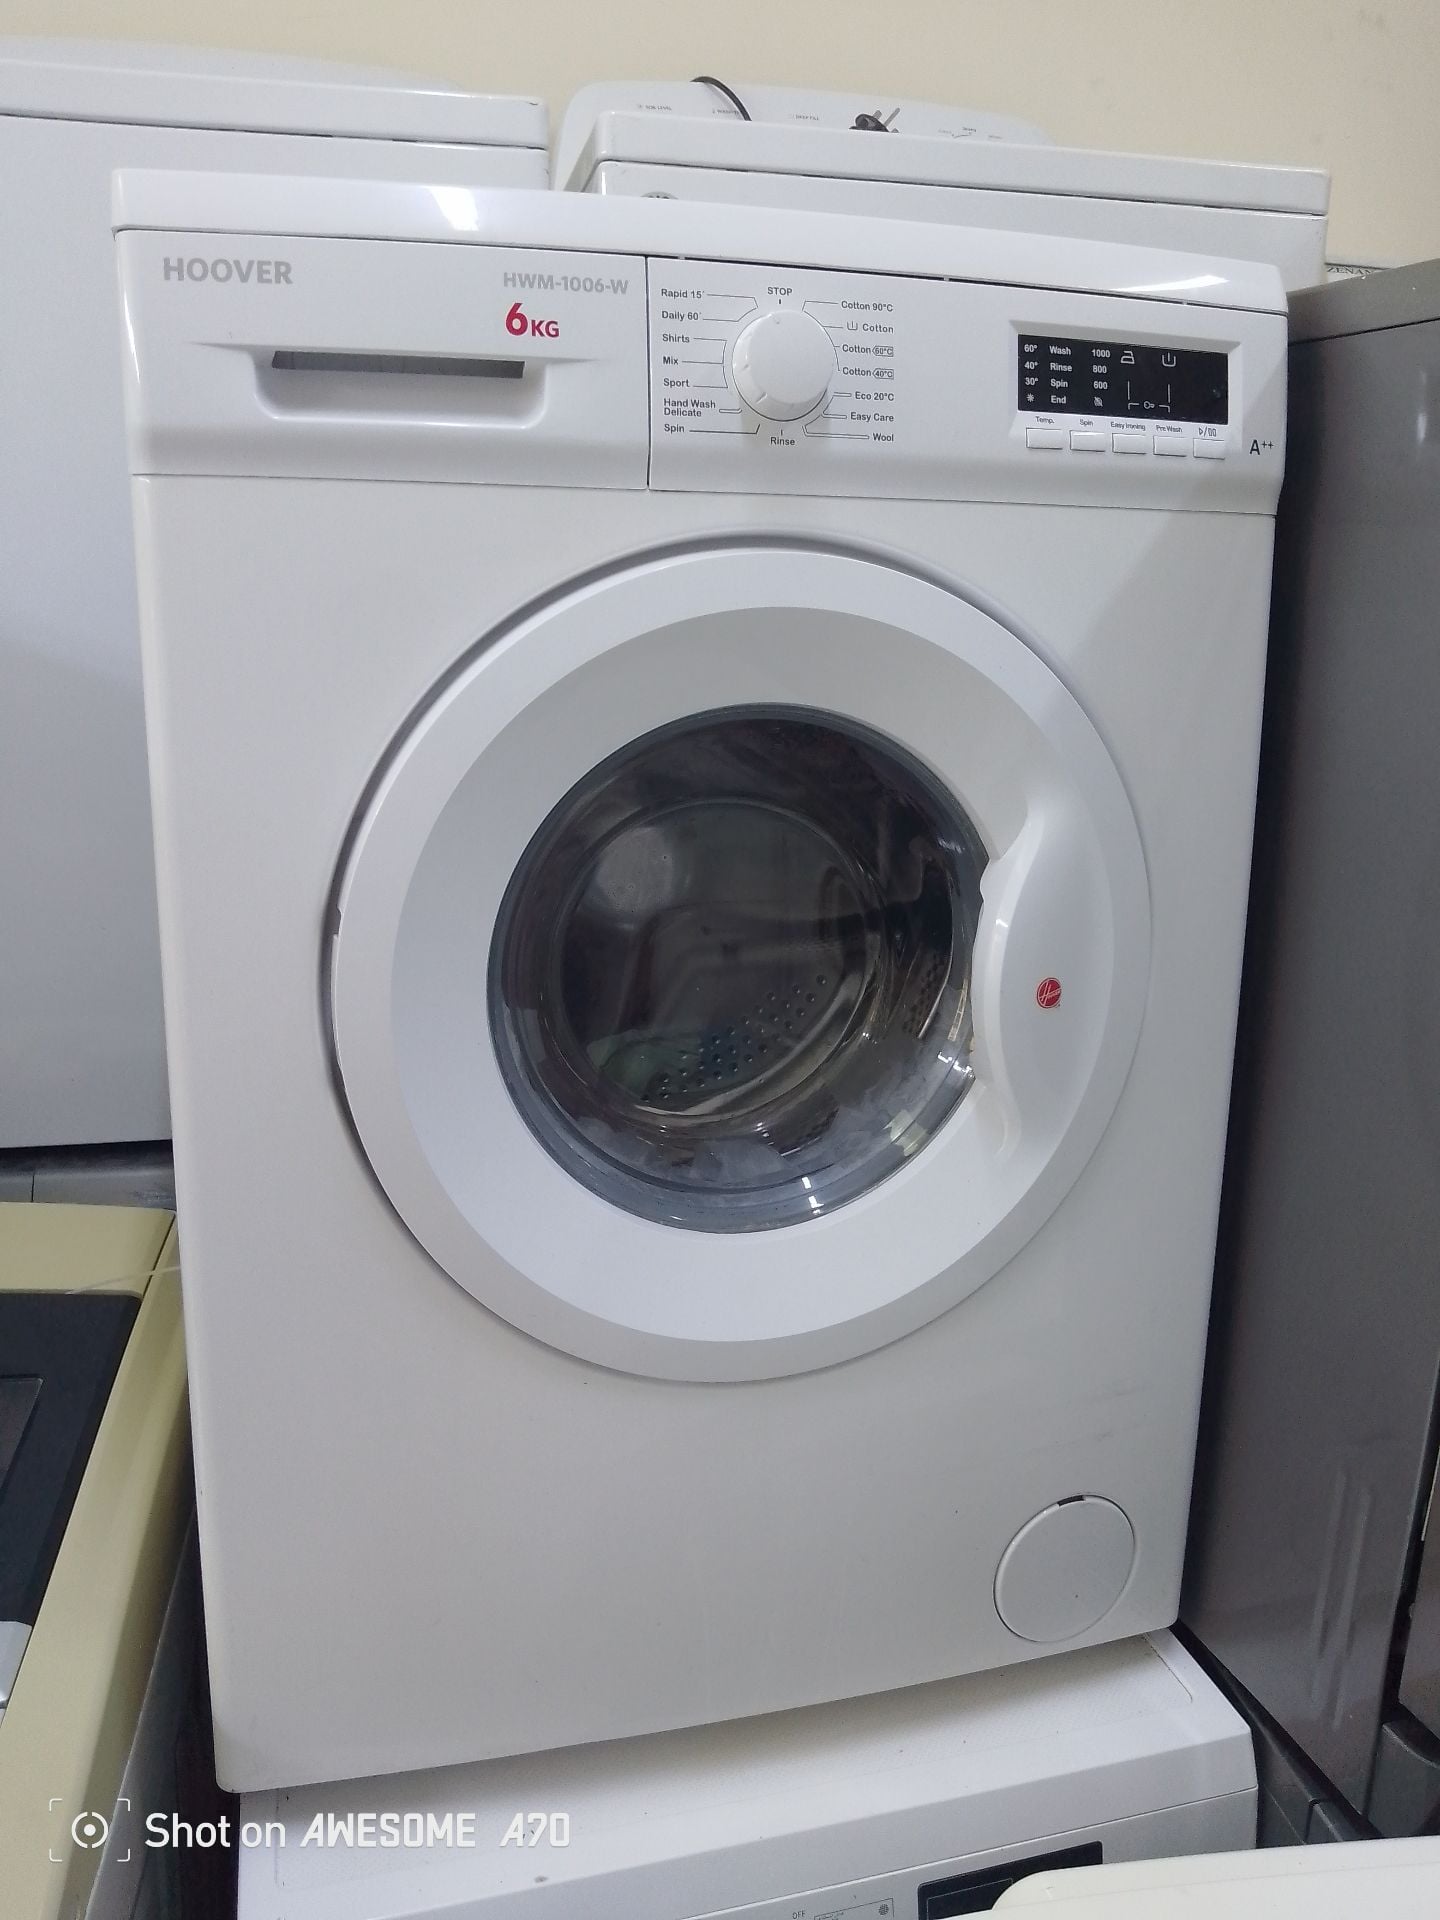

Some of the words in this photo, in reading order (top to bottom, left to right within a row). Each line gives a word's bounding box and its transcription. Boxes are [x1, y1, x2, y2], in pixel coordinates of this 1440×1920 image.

[163, 257, 293, 285] HOOVER
[503, 271, 629, 295] HWM-1006-W
[661, 289, 688, 299] Rapid
[768, 287, 792, 296] STOP
[841, 301, 870, 310] Cotton
[872, 303, 893, 312] 90°C
[662, 311, 685, 321] Daily
[862, 323, 893, 333] Cotton
[662, 334, 690, 343] Shirts
[842, 344, 871, 354] Cotton
[1049, 346, 1071, 355] Wash
[1092, 349, 1110, 358] 1000
[663, 356, 679, 365] Mix
[843, 367, 872, 376] Cotton
[1050, 363, 1072, 372] Rinse
[1093, 365, 1107, 374] 800
[664, 378, 690, 388] Sport
[1050, 379, 1068, 389] Spin
[1094, 381, 1108, 390] 600
[855, 392, 872, 400] Eco
[1051, 395, 1066, 404] End
[664, 399, 688, 408] Hand
[690, 400, 716, 409] Wash
[664, 407, 701, 417] Delicate
[850, 412, 871, 423] Easy
[873, 413, 894, 422] Care
[1080, 419, 1093, 427] Spin
[1111, 421, 1125, 430] Easy
[1125, 423, 1146, 432] Ironing
[664, 424, 684, 435] Spin
[1166, 425, 1182, 433] Wash
[770, 437, 795, 446] Rinse
[873, 433, 894, 442] Wool
[792, 1910, 806, 1919] OFF
